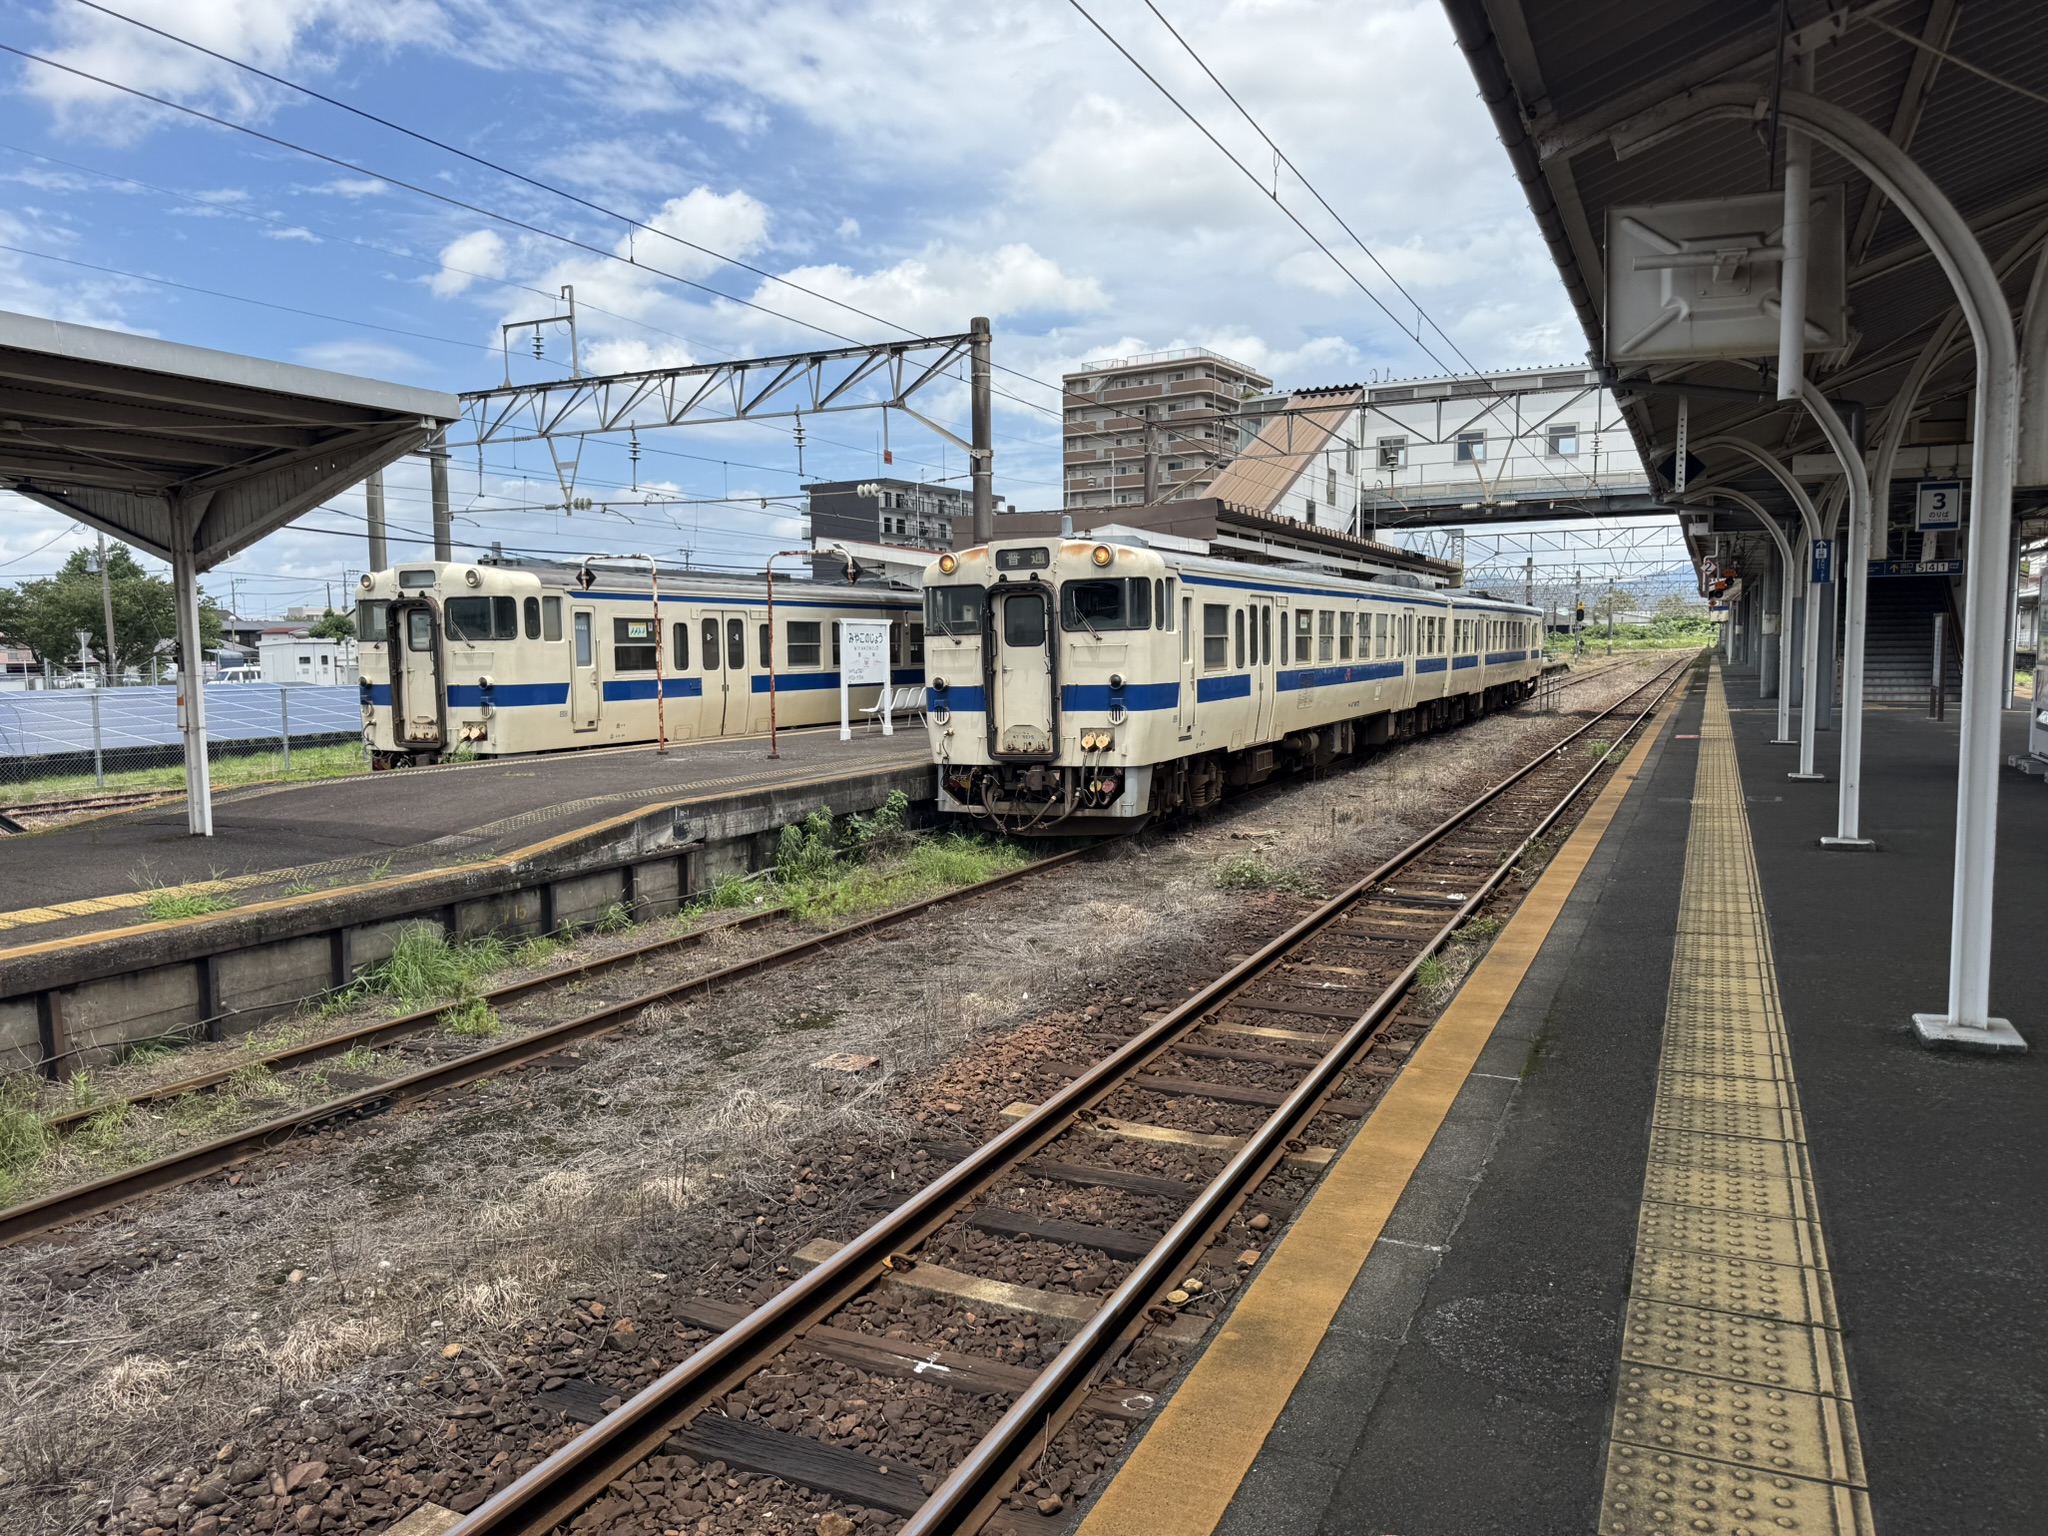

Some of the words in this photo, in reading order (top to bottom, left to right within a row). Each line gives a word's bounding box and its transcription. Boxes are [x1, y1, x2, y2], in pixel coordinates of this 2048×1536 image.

[1932, 492, 1946, 510] 3
[1006, 551, 1046, 566] 普通
[1705, 562, 1712, 573] 2
[848, 632, 883, 644] みやこのじょう
